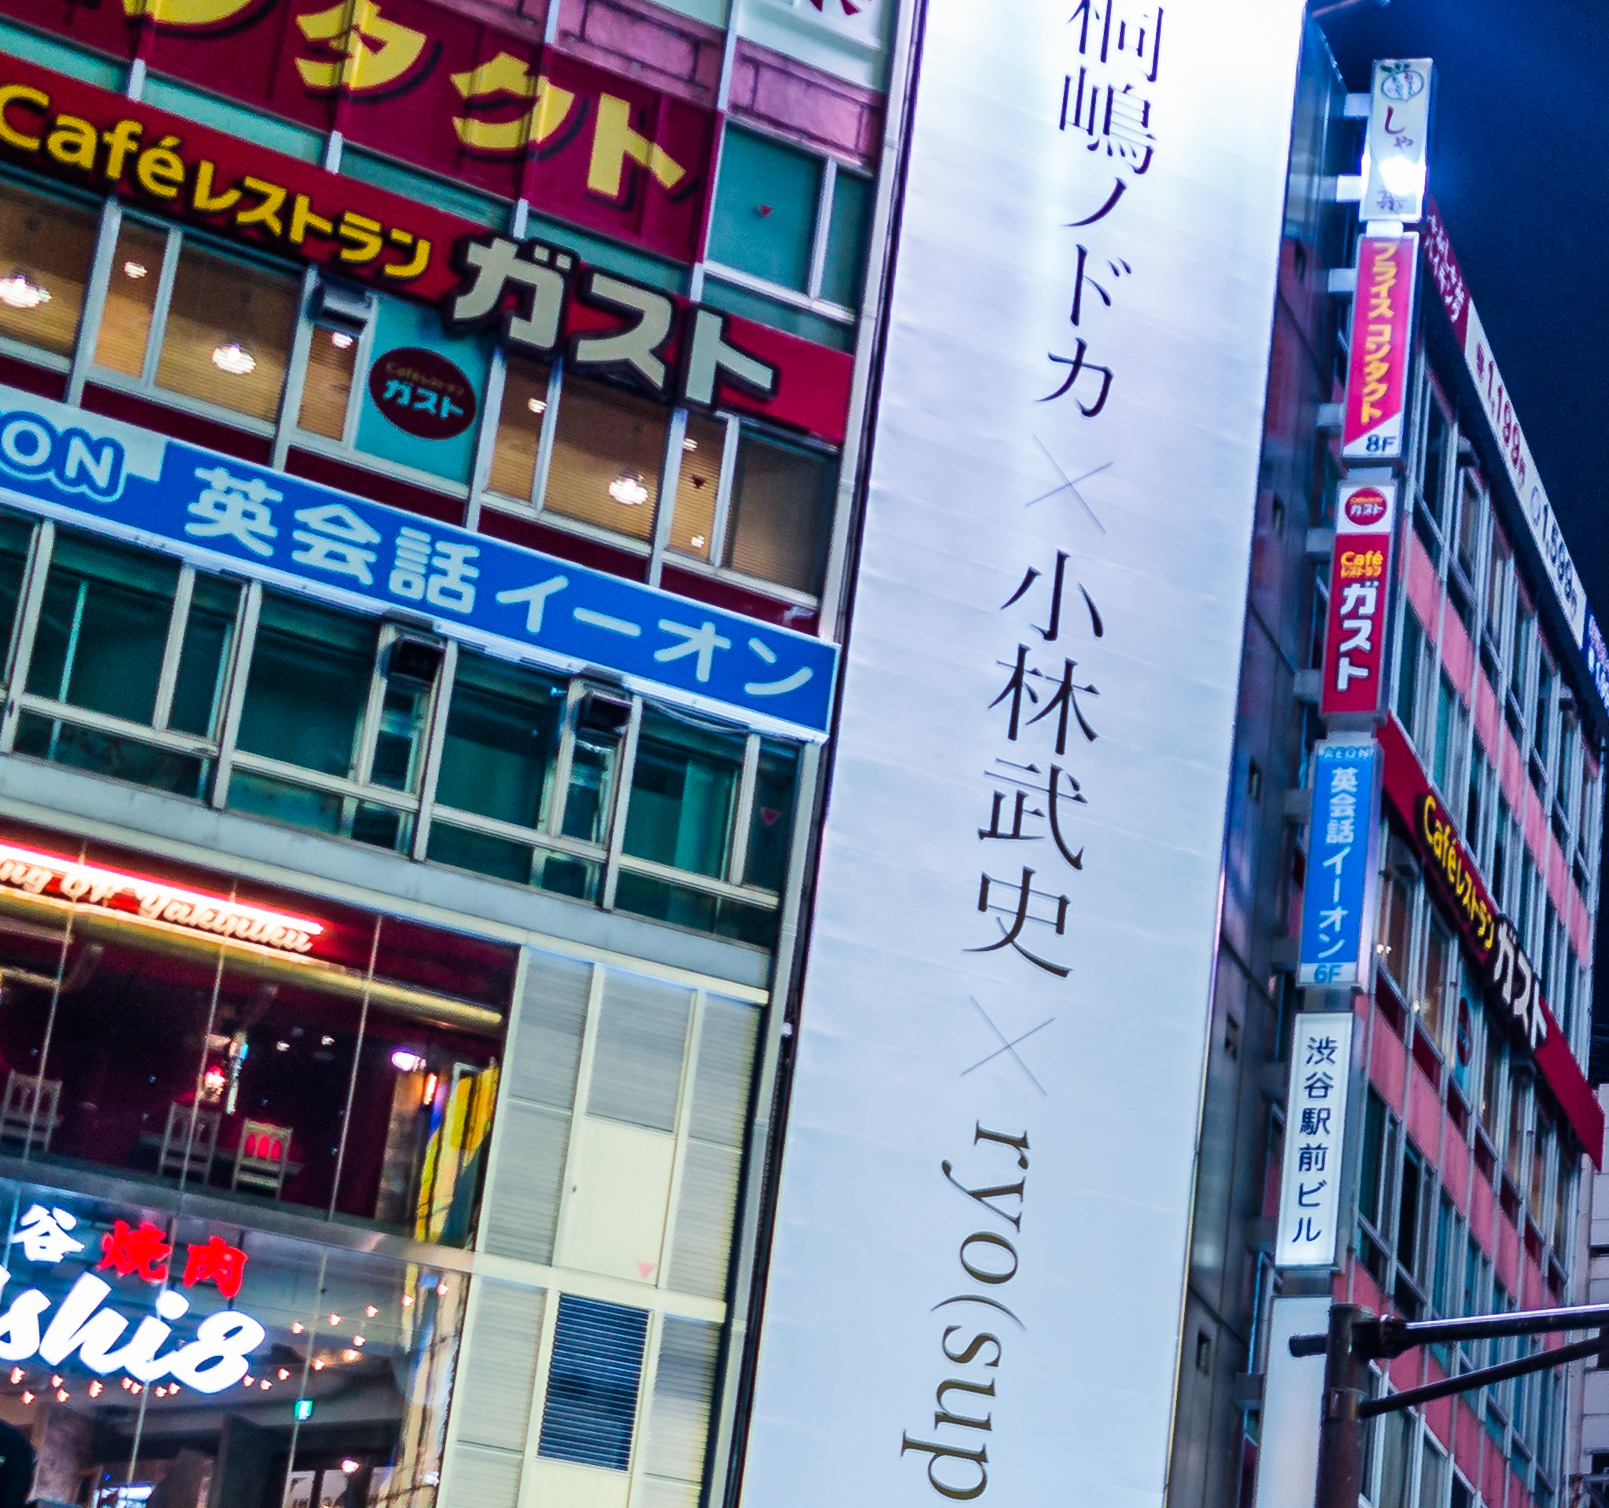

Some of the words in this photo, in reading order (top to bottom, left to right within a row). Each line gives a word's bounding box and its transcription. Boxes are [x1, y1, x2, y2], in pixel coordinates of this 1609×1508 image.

[1033, 0, 1164, 418] 桐嶋ノドカ
[452, 236, 775, 404] ガスト
[382, 378, 466, 422] ガスト
[1365, 434, 1396, 453] 8F
[1340, 551, 1383, 567] Café
[1336, 581, 1379, 692] ガスト
[962, 549, 1104, 978] 小林武史
[1317, 767, 1360, 959] 英会話イーオン
[1313, 963, 1343, 983] 6F
[1291, 1036, 1340, 1243] 渋谷駅前ビル
[0, 1268, 265, 1394] shi8
